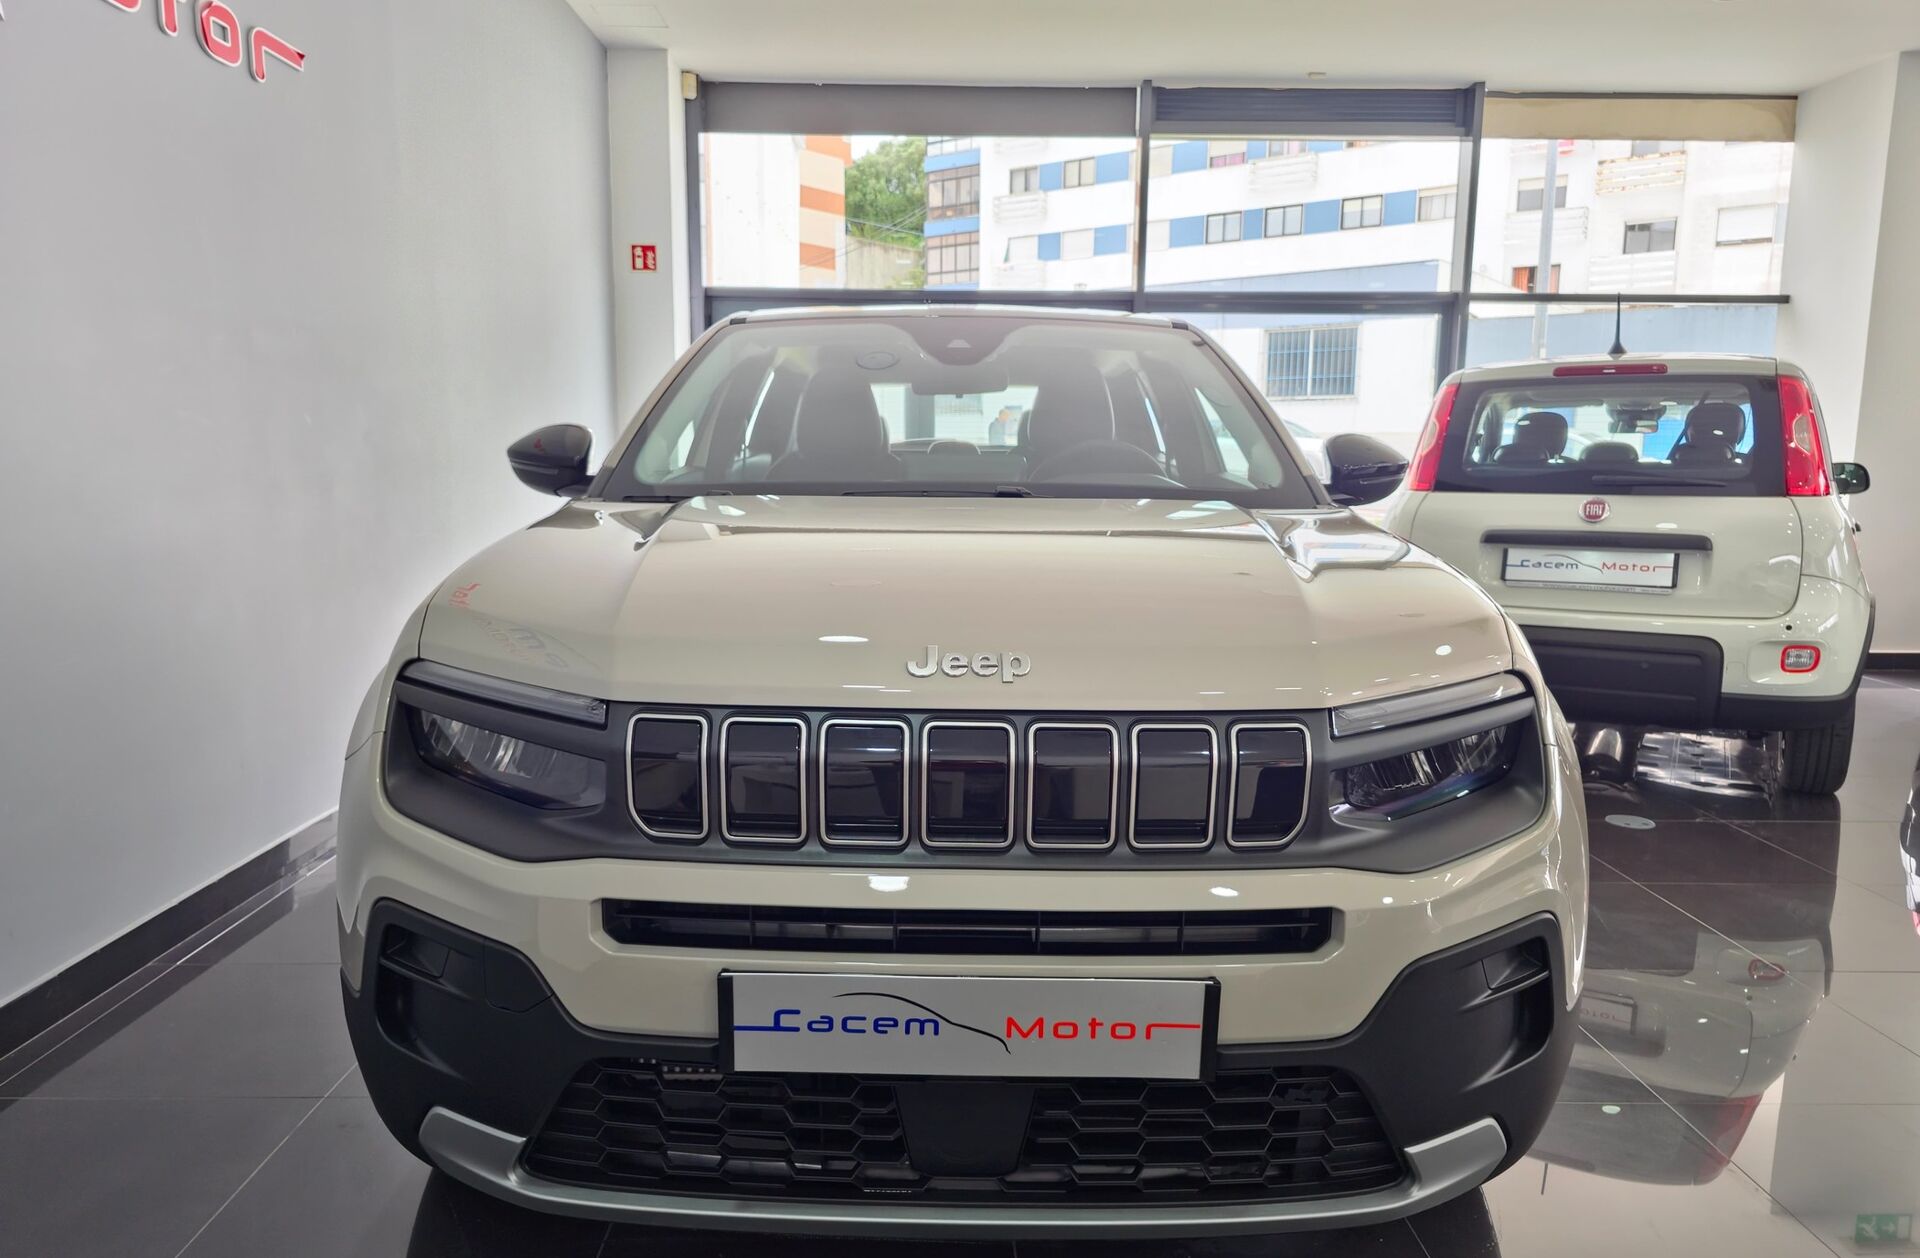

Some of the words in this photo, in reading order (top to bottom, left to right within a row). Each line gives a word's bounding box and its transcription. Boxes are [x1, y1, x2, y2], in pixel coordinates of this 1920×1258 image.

[1586, 503, 1604, 516] FIAT
[1506, 559, 1579, 570] Cacem
[1602, 561, 1674, 572] Motor
[906, 644, 1031, 684] Jeep
[734, 1009, 940, 1036] Cacem
[1006, 1016, 1201, 1041] Motor
